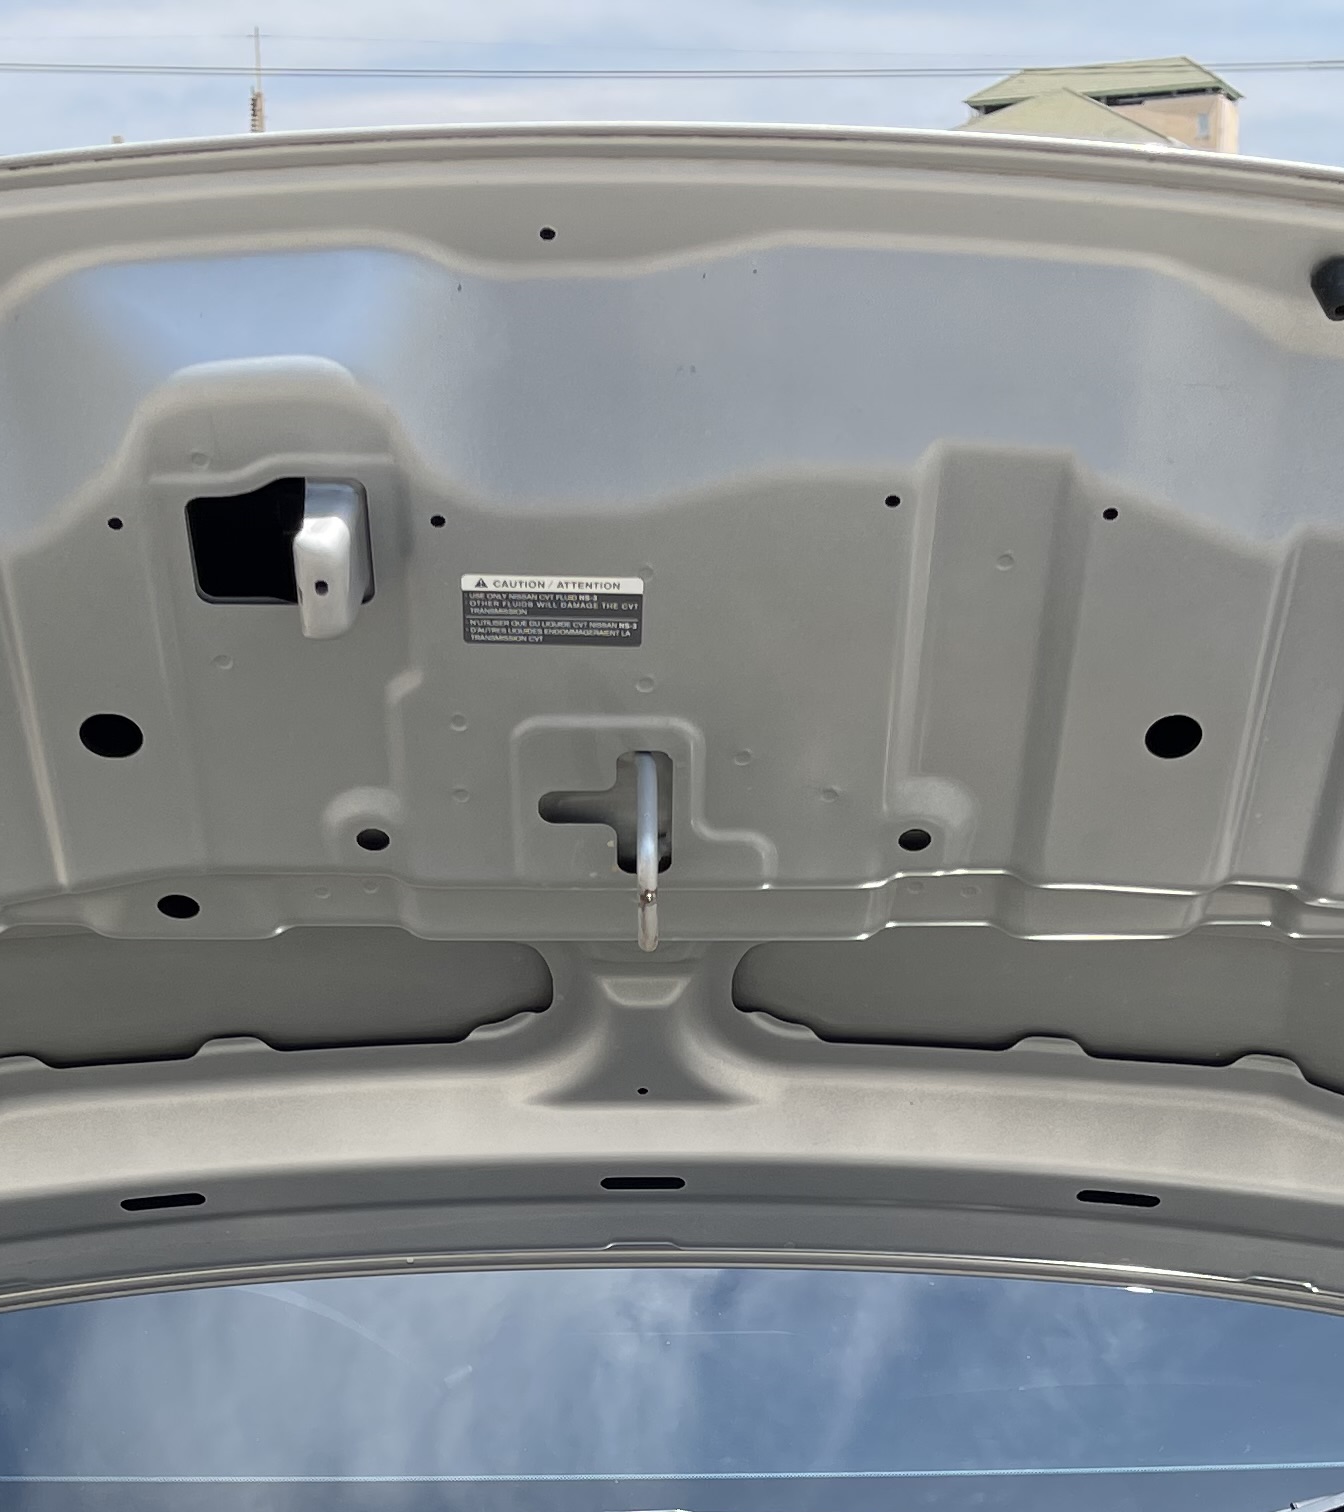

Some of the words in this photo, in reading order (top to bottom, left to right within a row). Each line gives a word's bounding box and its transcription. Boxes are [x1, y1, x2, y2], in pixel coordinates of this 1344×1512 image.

[492, 579, 546, 589] CAUTION
[556, 580, 621, 590] ATTENTION
[578, 594, 598, 602] NS-3
[470, 600, 500, 608] OTHER
[560, 602, 598, 610] DAMAGE
[618, 622, 638, 630] NS-3
